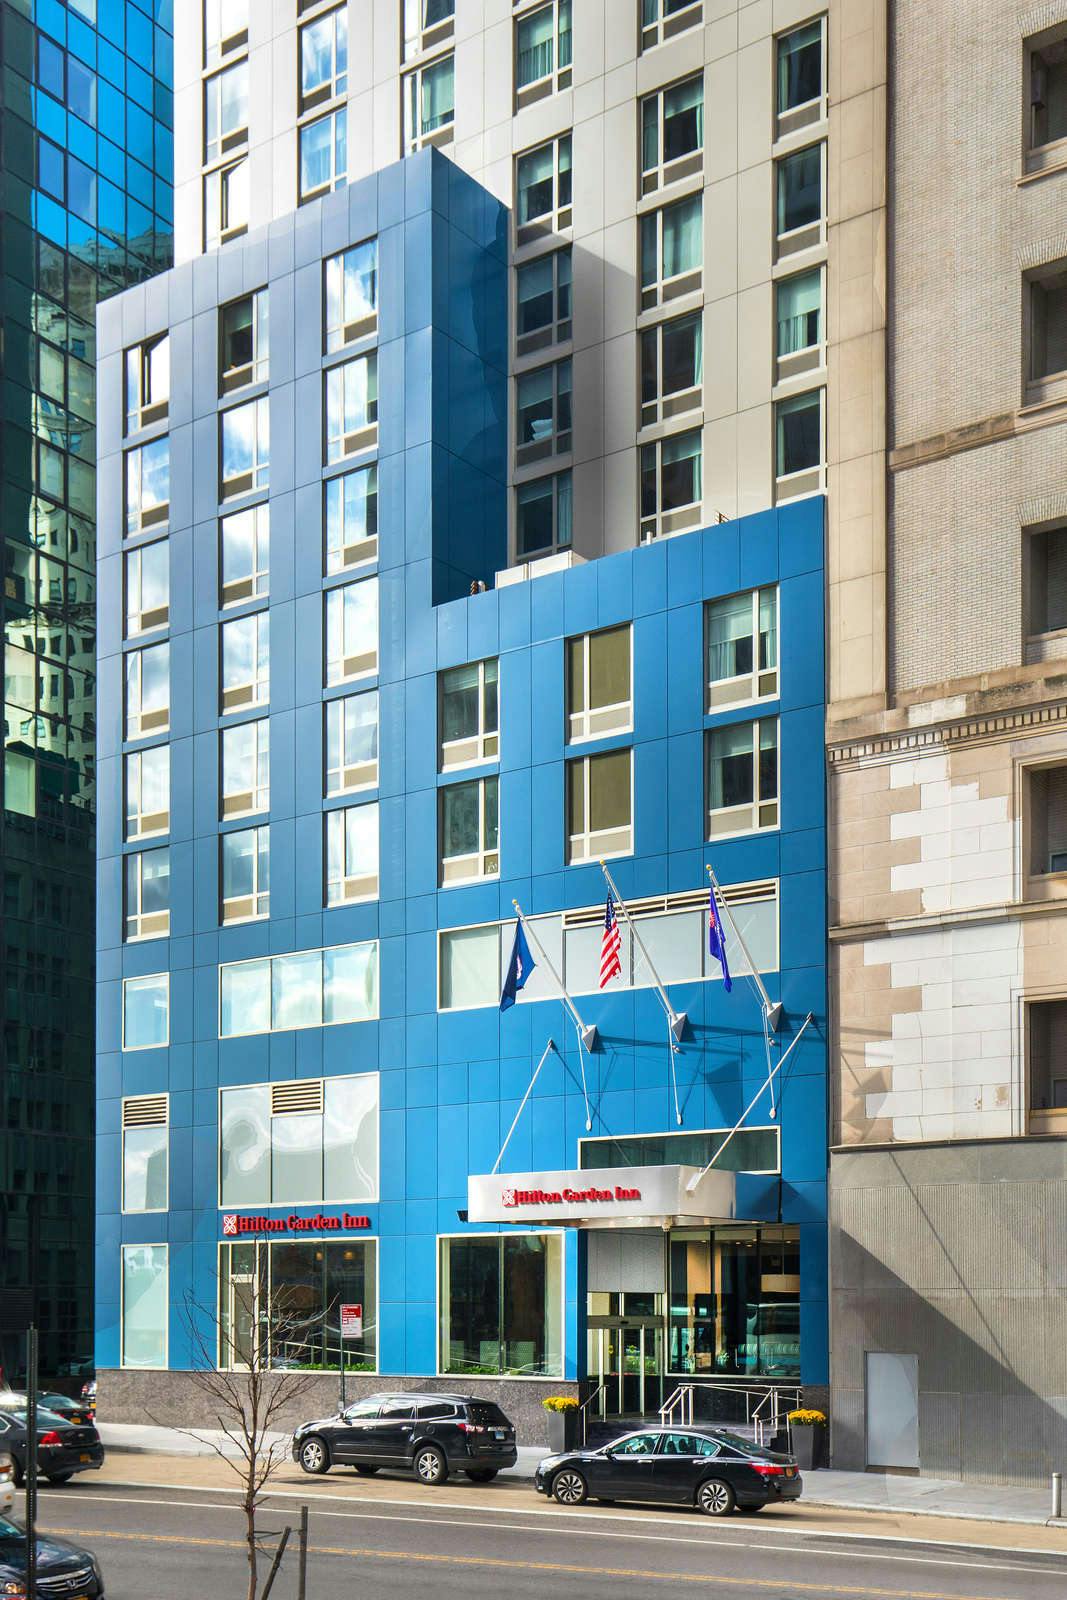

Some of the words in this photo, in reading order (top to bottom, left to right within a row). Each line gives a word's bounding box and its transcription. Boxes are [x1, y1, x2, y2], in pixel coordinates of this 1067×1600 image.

[517, 1188, 561, 1203] Hilton
[562, 1187, 613, 1202] Garden
[615, 1185, 641, 1200] Inn
[239, 1215, 285, 1232] Hilton
[287, 1214, 339, 1230] Garden
[342, 1212, 369, 1229] Inn
